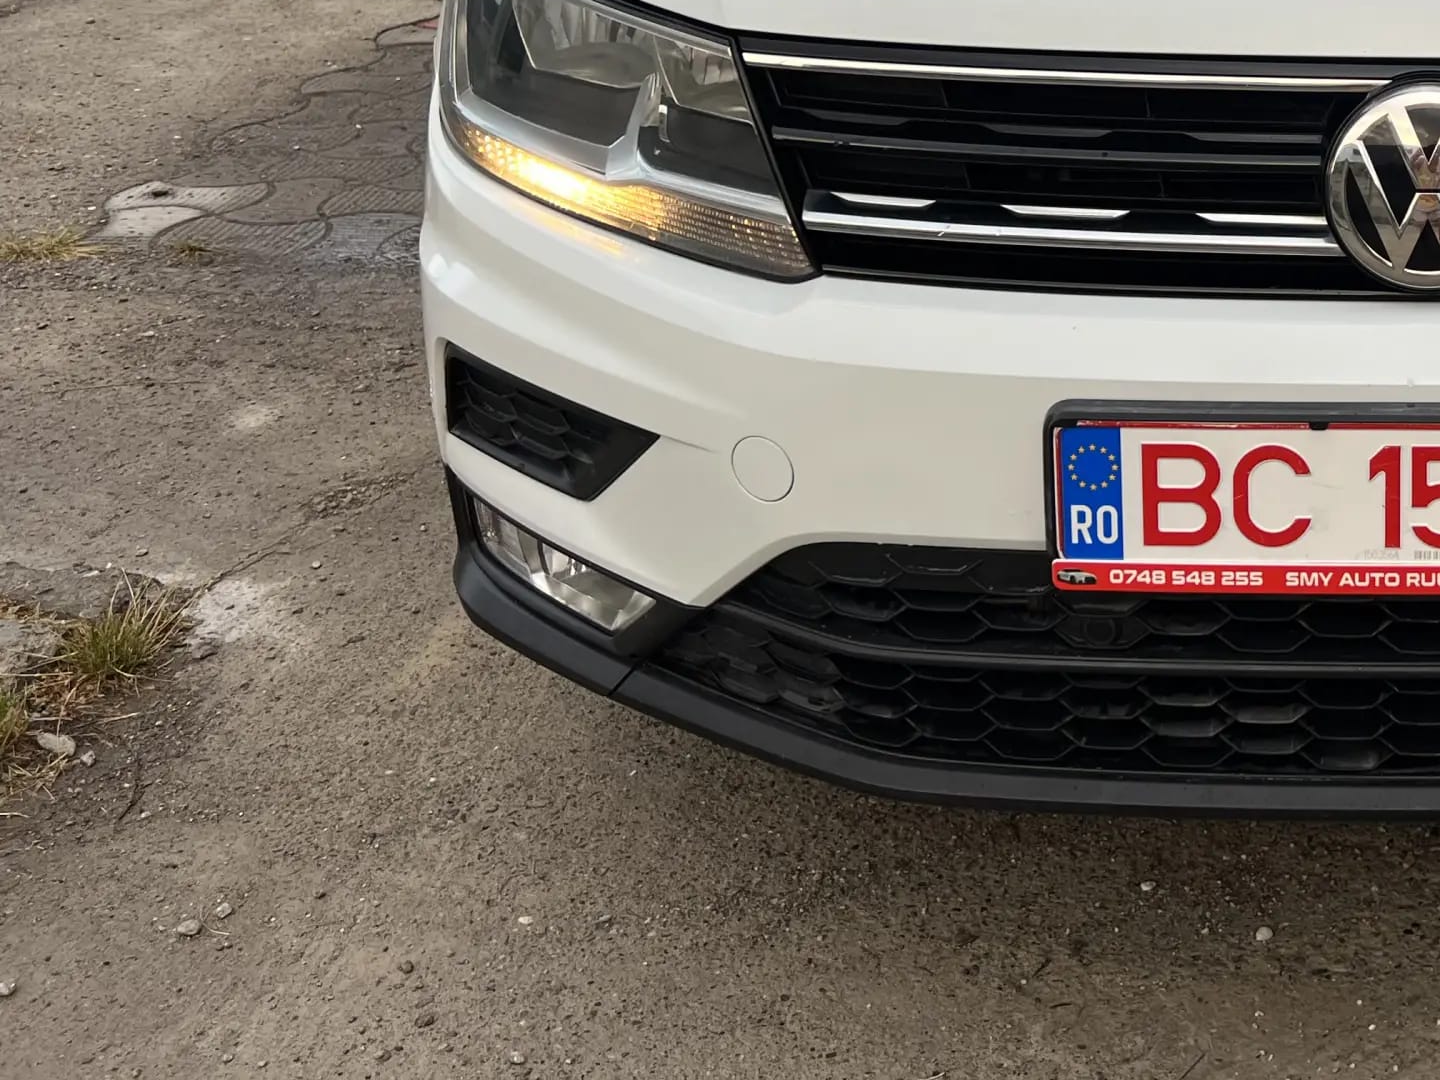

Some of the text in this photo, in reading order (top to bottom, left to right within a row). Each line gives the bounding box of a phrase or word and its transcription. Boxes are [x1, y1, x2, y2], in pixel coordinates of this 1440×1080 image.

[1141, 443, 1312, 548] BC
[1070, 504, 1119, 544] RO
[1109, 569, 1166, 585] 0748
[1171, 570, 1215, 586] 548
[1220, 571, 1264, 587] 255
[1285, 571, 1333, 587] SMY
[1338, 572, 1401, 587] AUTO
